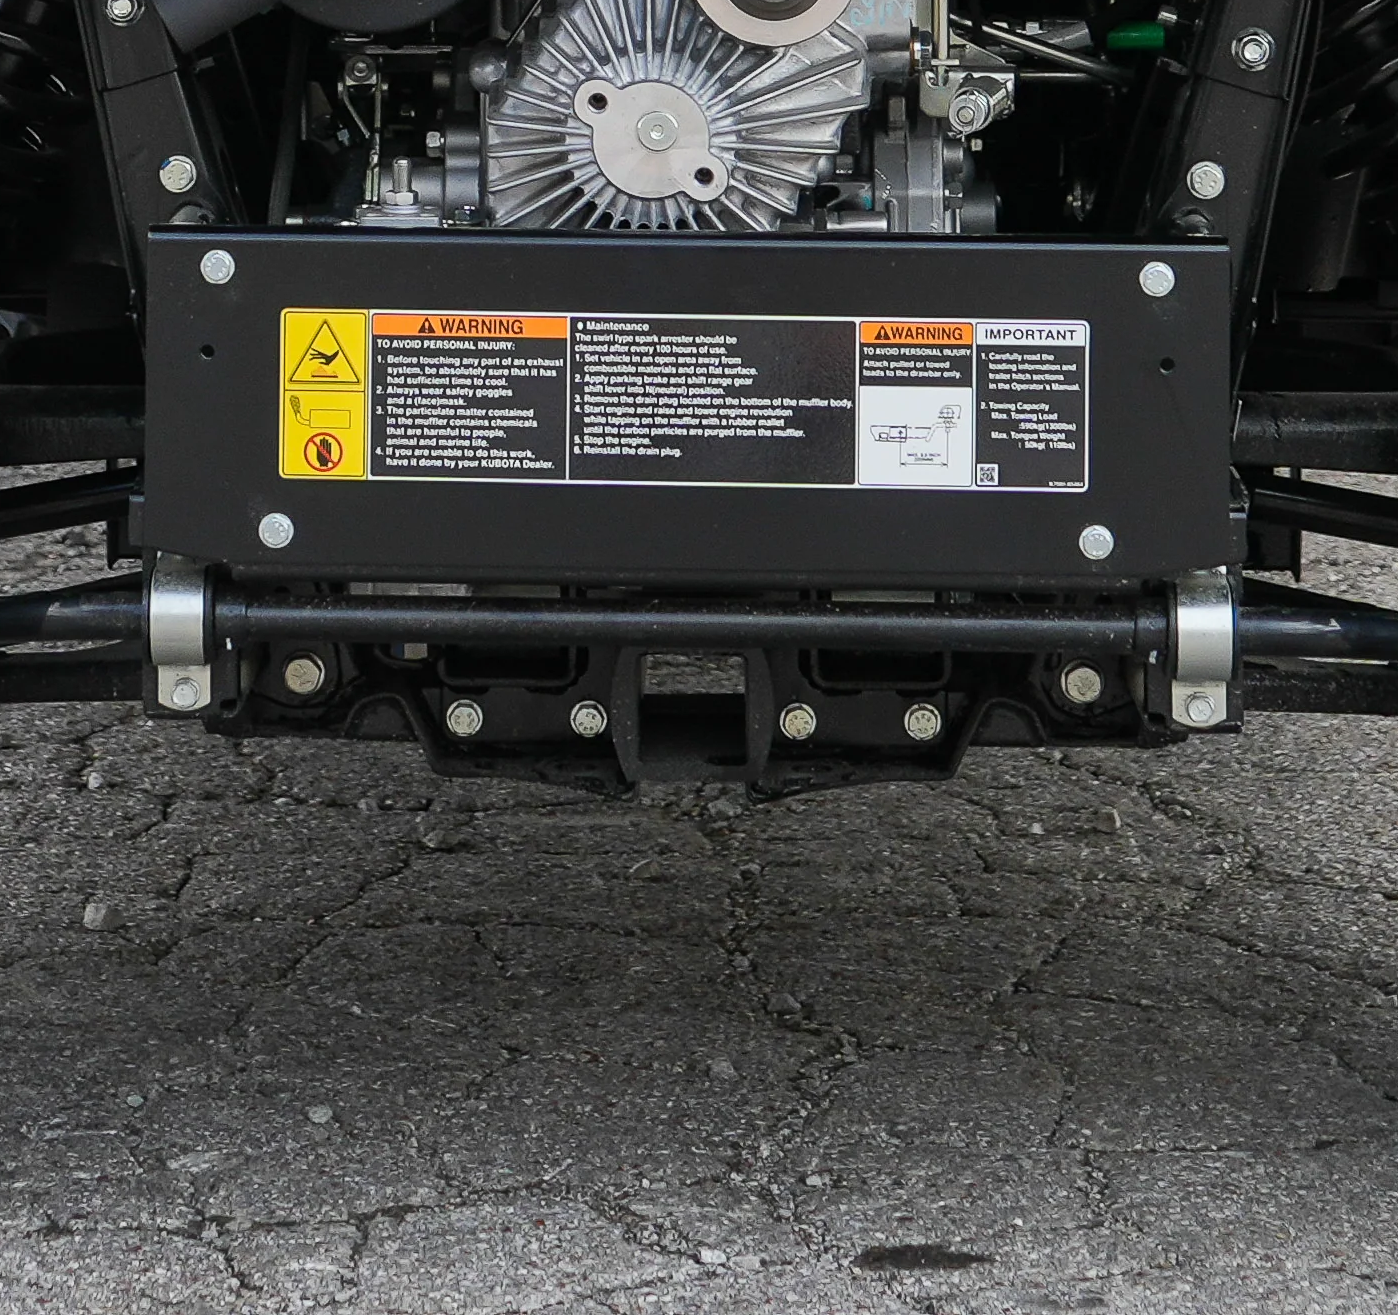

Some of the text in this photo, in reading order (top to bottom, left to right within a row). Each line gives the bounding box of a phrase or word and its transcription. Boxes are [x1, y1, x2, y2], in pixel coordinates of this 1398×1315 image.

[439, 318, 524, 335] WARNING
[587, 321, 649, 331] Maintenance
[890, 326, 963, 340] WARNING
[985, 328, 1077, 340] IMPORTANT
[377, 339, 515, 351] TO AVOID PERSONAL INJURY:
[377, 355, 563, 369] 1. Before touching any part of an exhaust
[387, 365, 423, 376] system,
[424, 366, 437, 374] be
[438, 366, 486, 377] absolutely
[510, 367, 529, 376] that
[530, 367, 537, 376] it
[539, 367, 557, 376] has
[387, 375, 509, 385] had sufficient time to cool.
[376, 386, 384, 394] 2.
[386, 386, 419, 397] Always
[445, 387, 473, 397] safety
[475, 388, 513, 398] goggles
[387, 397, 404, 405] and
[375, 407, 535, 418] 3. The particulate matter contained
[387, 417, 537, 427] in the muffler contains chemicals
[386, 427, 404, 435] that
[423, 427, 459, 436] harmful
[460, 428, 471, 436] to
[472, 428, 507, 438] people,
[385, 437, 489, 447] animal and marine life.
[375, 447, 383, 455] 4.
[385, 447, 392, 455] If
[394, 449, 412, 457] you
[430, 448, 462, 456] unable
[463, 448, 474, 457] to
[475, 449, 488, 457] do
[489, 449, 507, 457] this
[509, 449, 535, 459] work,
[385, 457, 555, 470] have it done by your KUBOTA Dealer.
